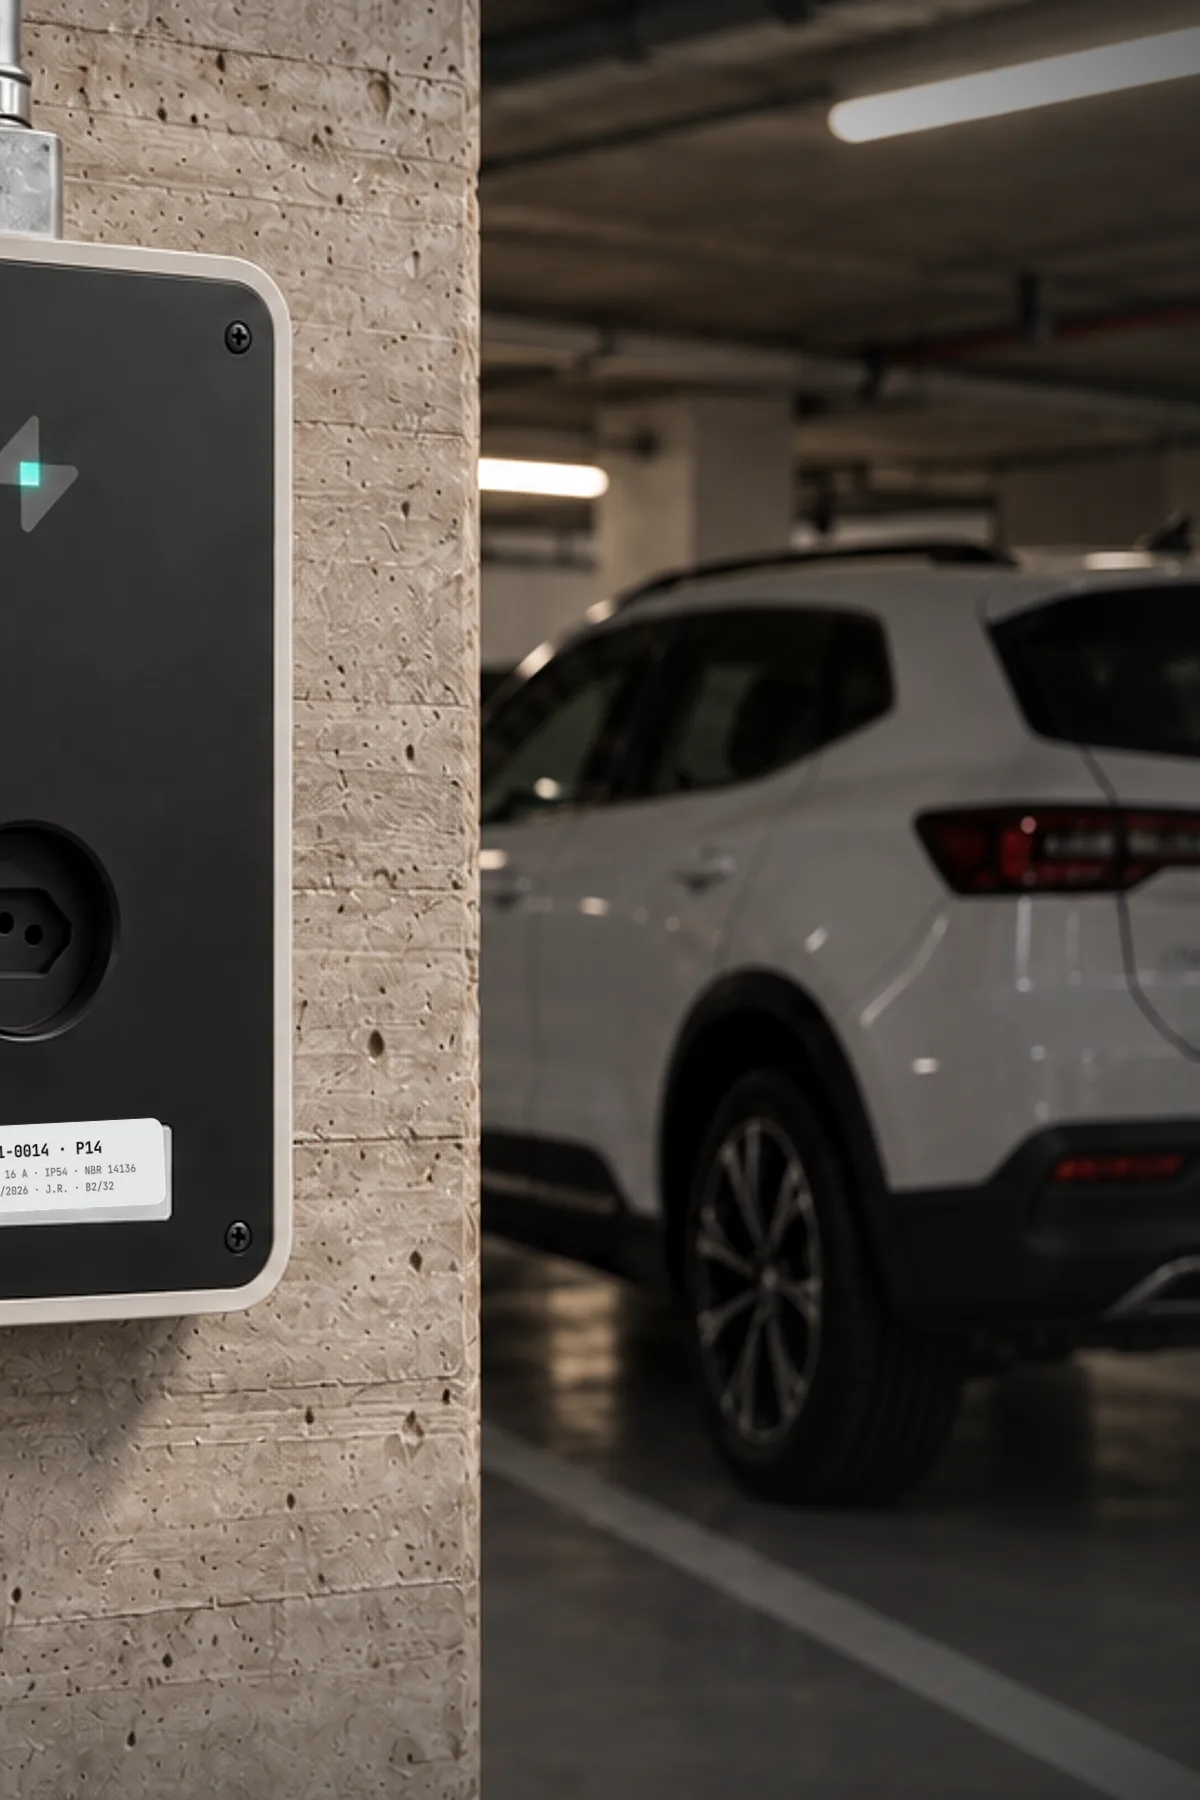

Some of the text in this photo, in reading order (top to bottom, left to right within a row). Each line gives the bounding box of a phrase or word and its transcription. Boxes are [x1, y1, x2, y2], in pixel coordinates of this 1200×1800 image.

[76, 1141, 102, 1155] P14
[5, 1170, 16, 1179] 16
[22, 1169, 28, 1178] A
[45, 1167, 68, 1177] IP54
[84, 1165, 102, 1175] NBR
[108, 1164, 136, 1174] 14136
[45, 1184, 67, 1194] J.R.
[85, 1181, 114, 1192] B2/32
